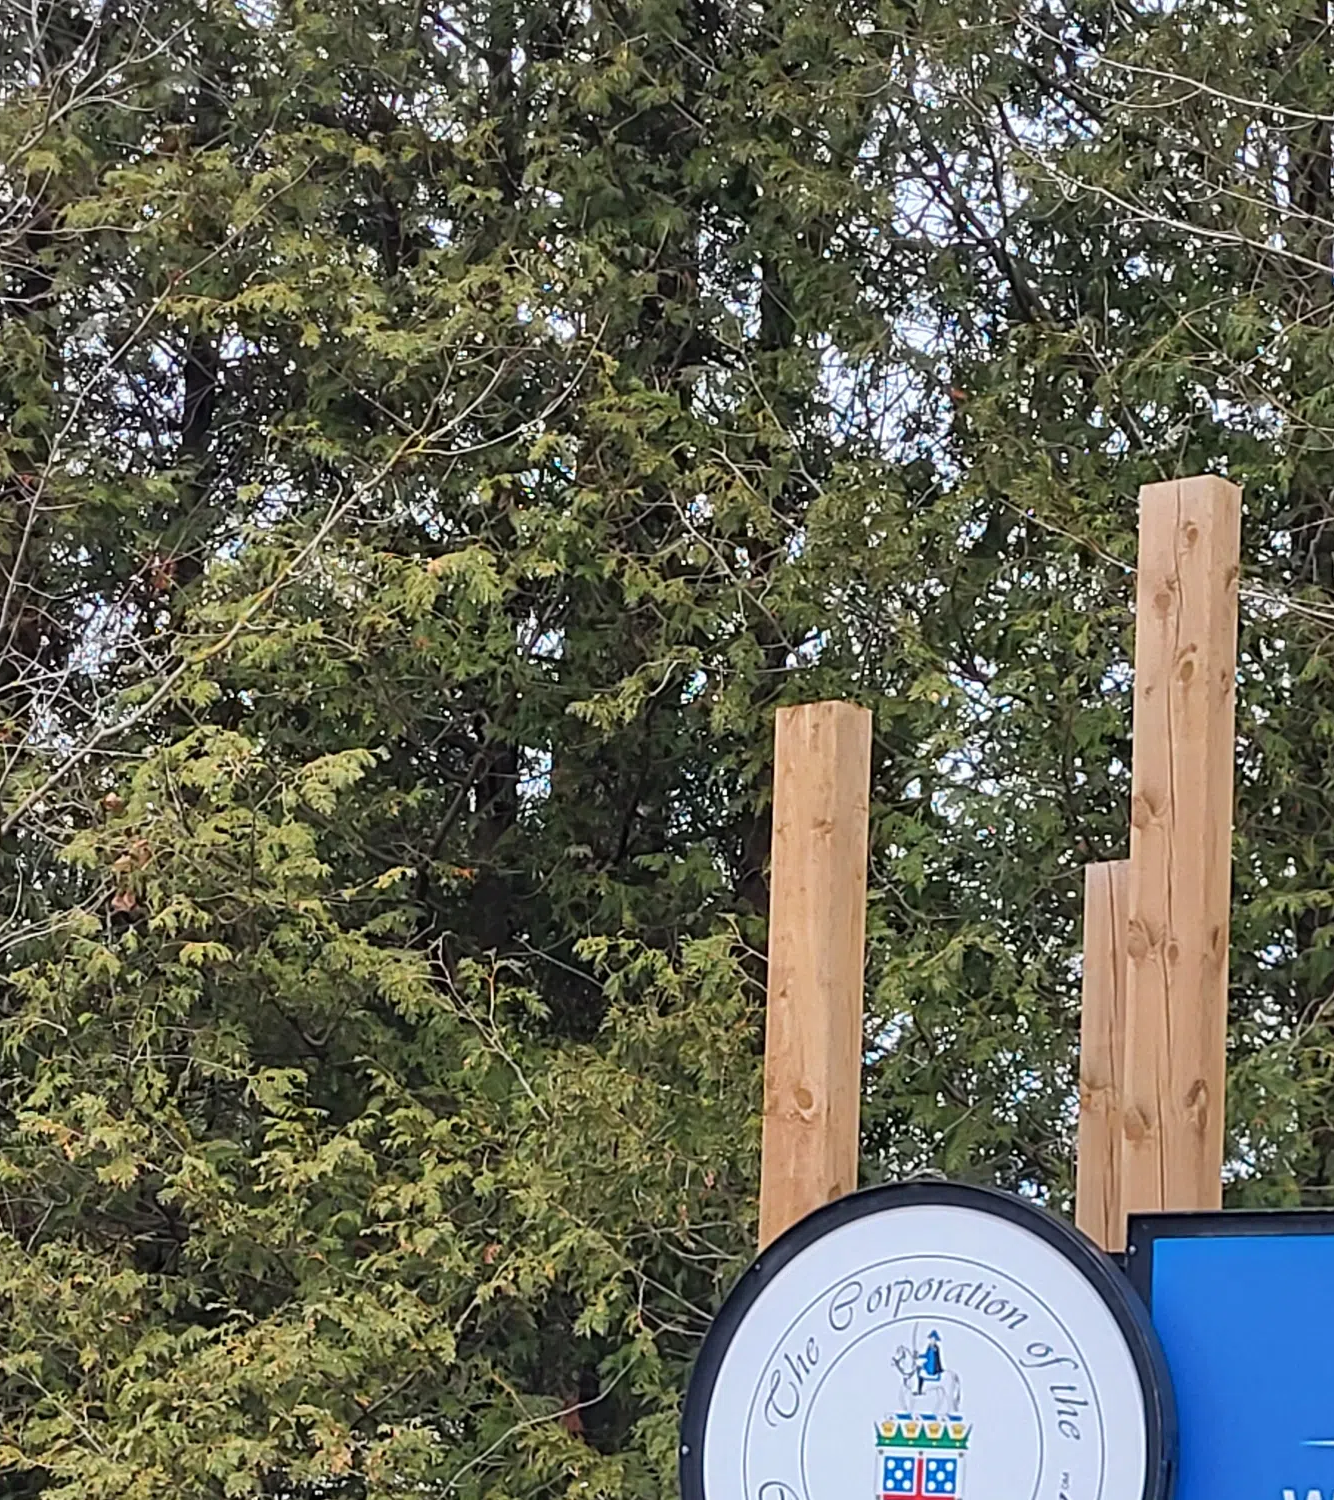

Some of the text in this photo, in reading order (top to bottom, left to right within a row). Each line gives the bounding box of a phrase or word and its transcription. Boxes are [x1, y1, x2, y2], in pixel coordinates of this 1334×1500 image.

[765, 1275, 1089, 1441] The Corporation of the
